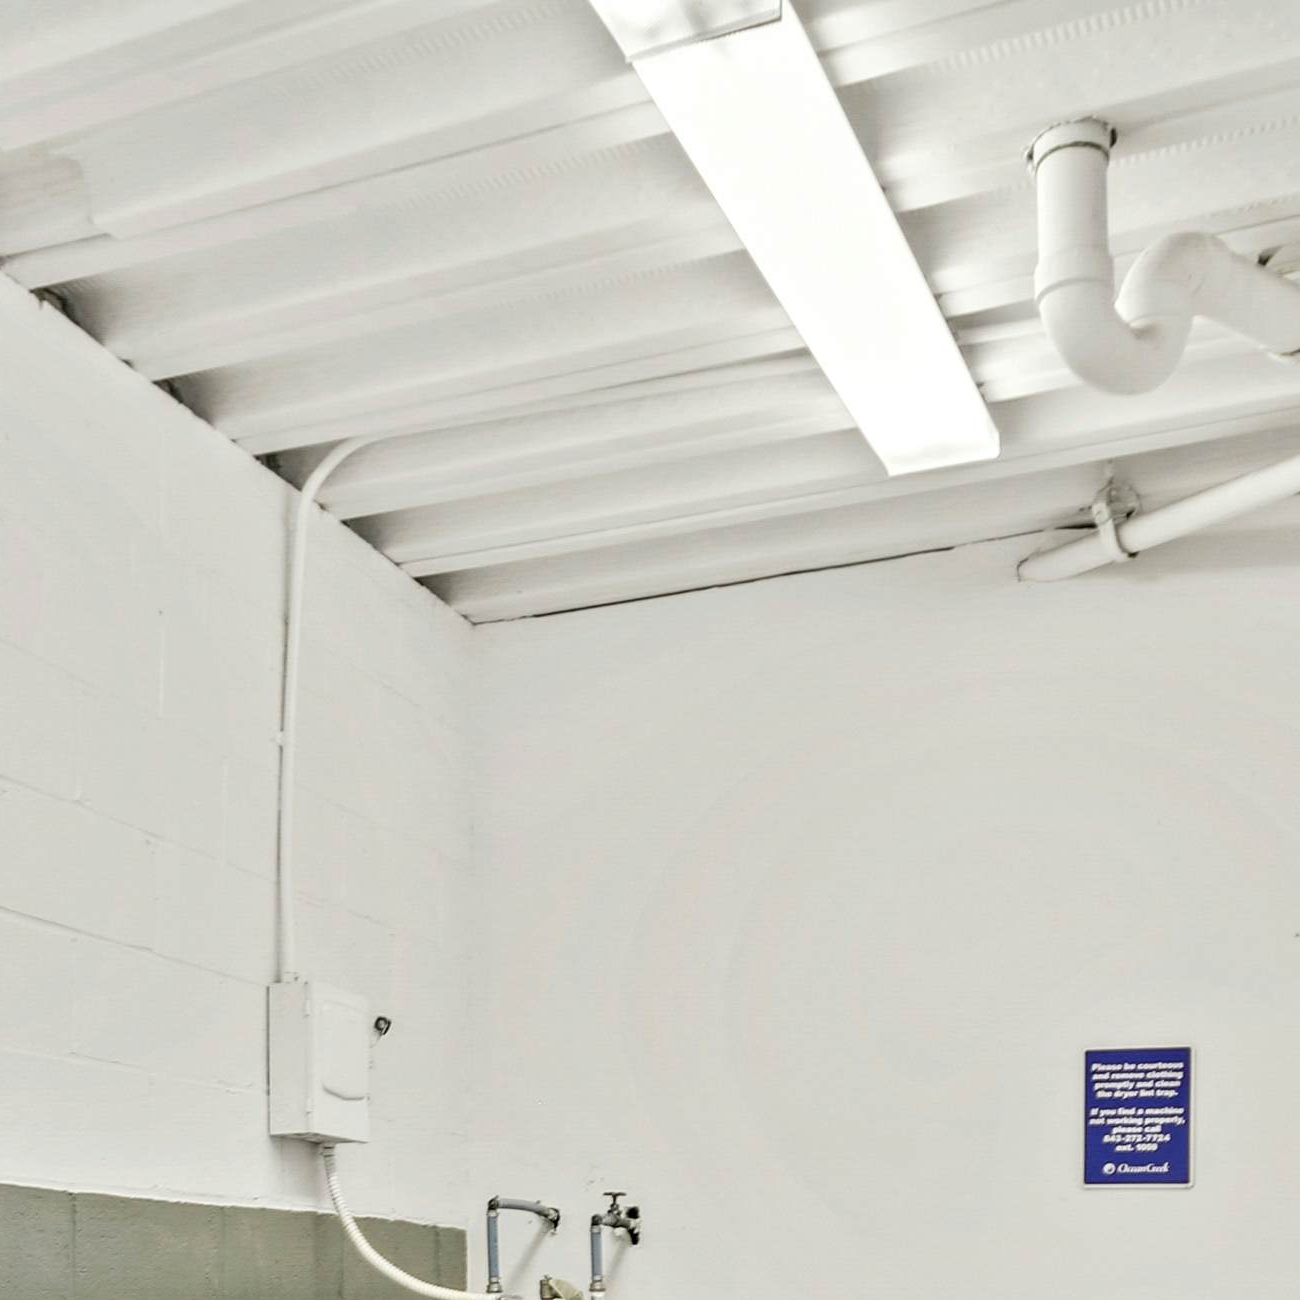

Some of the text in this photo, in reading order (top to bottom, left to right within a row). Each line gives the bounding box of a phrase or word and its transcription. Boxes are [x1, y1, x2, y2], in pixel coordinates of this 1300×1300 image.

[1092, 1062, 1184, 1071] Please be courteous
[1092, 1072, 1110, 1080] and
[1146, 1070, 1184, 1079] clothing
[1094, 1080, 1135, 1090] promptly
[1136, 1080, 1154, 1088] and
[1096, 1089, 1179, 1099] the dryer lint trap.
[1099, 1109, 1117, 1117] you
[1117, 1107, 1136, 1115] find
[1145, 1107, 1184, 1115] machine
[1089, 1116, 1186, 1126] not working properly,
[1111, 1125, 1162, 1134] please call
